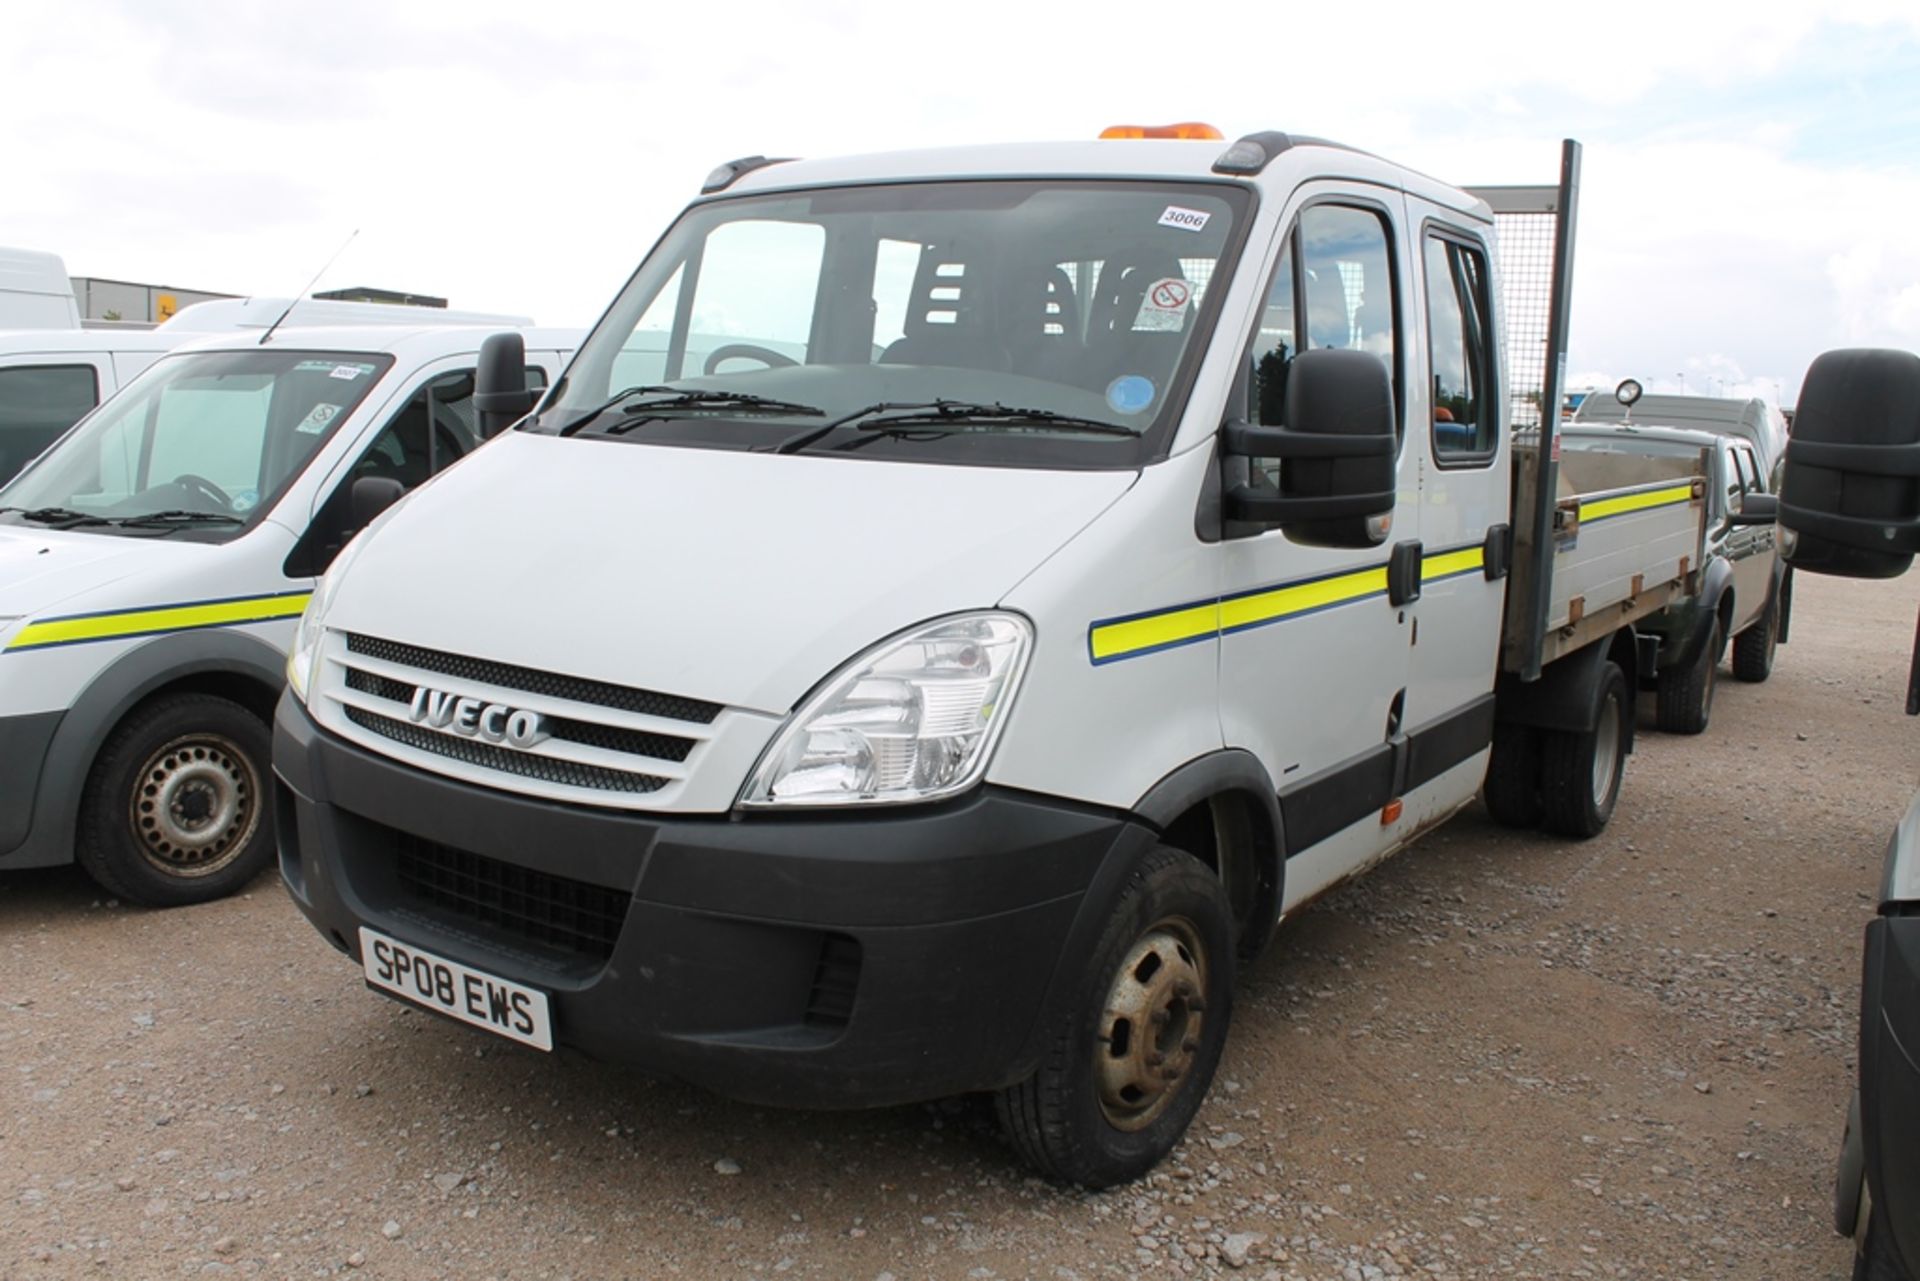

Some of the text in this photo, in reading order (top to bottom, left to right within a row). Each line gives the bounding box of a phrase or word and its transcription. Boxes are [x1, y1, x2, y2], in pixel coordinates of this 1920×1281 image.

[1164, 210, 1204, 227] 3006
[409, 687, 544, 748] IVECO
[373, 939, 534, 1036] SP08 EWS
